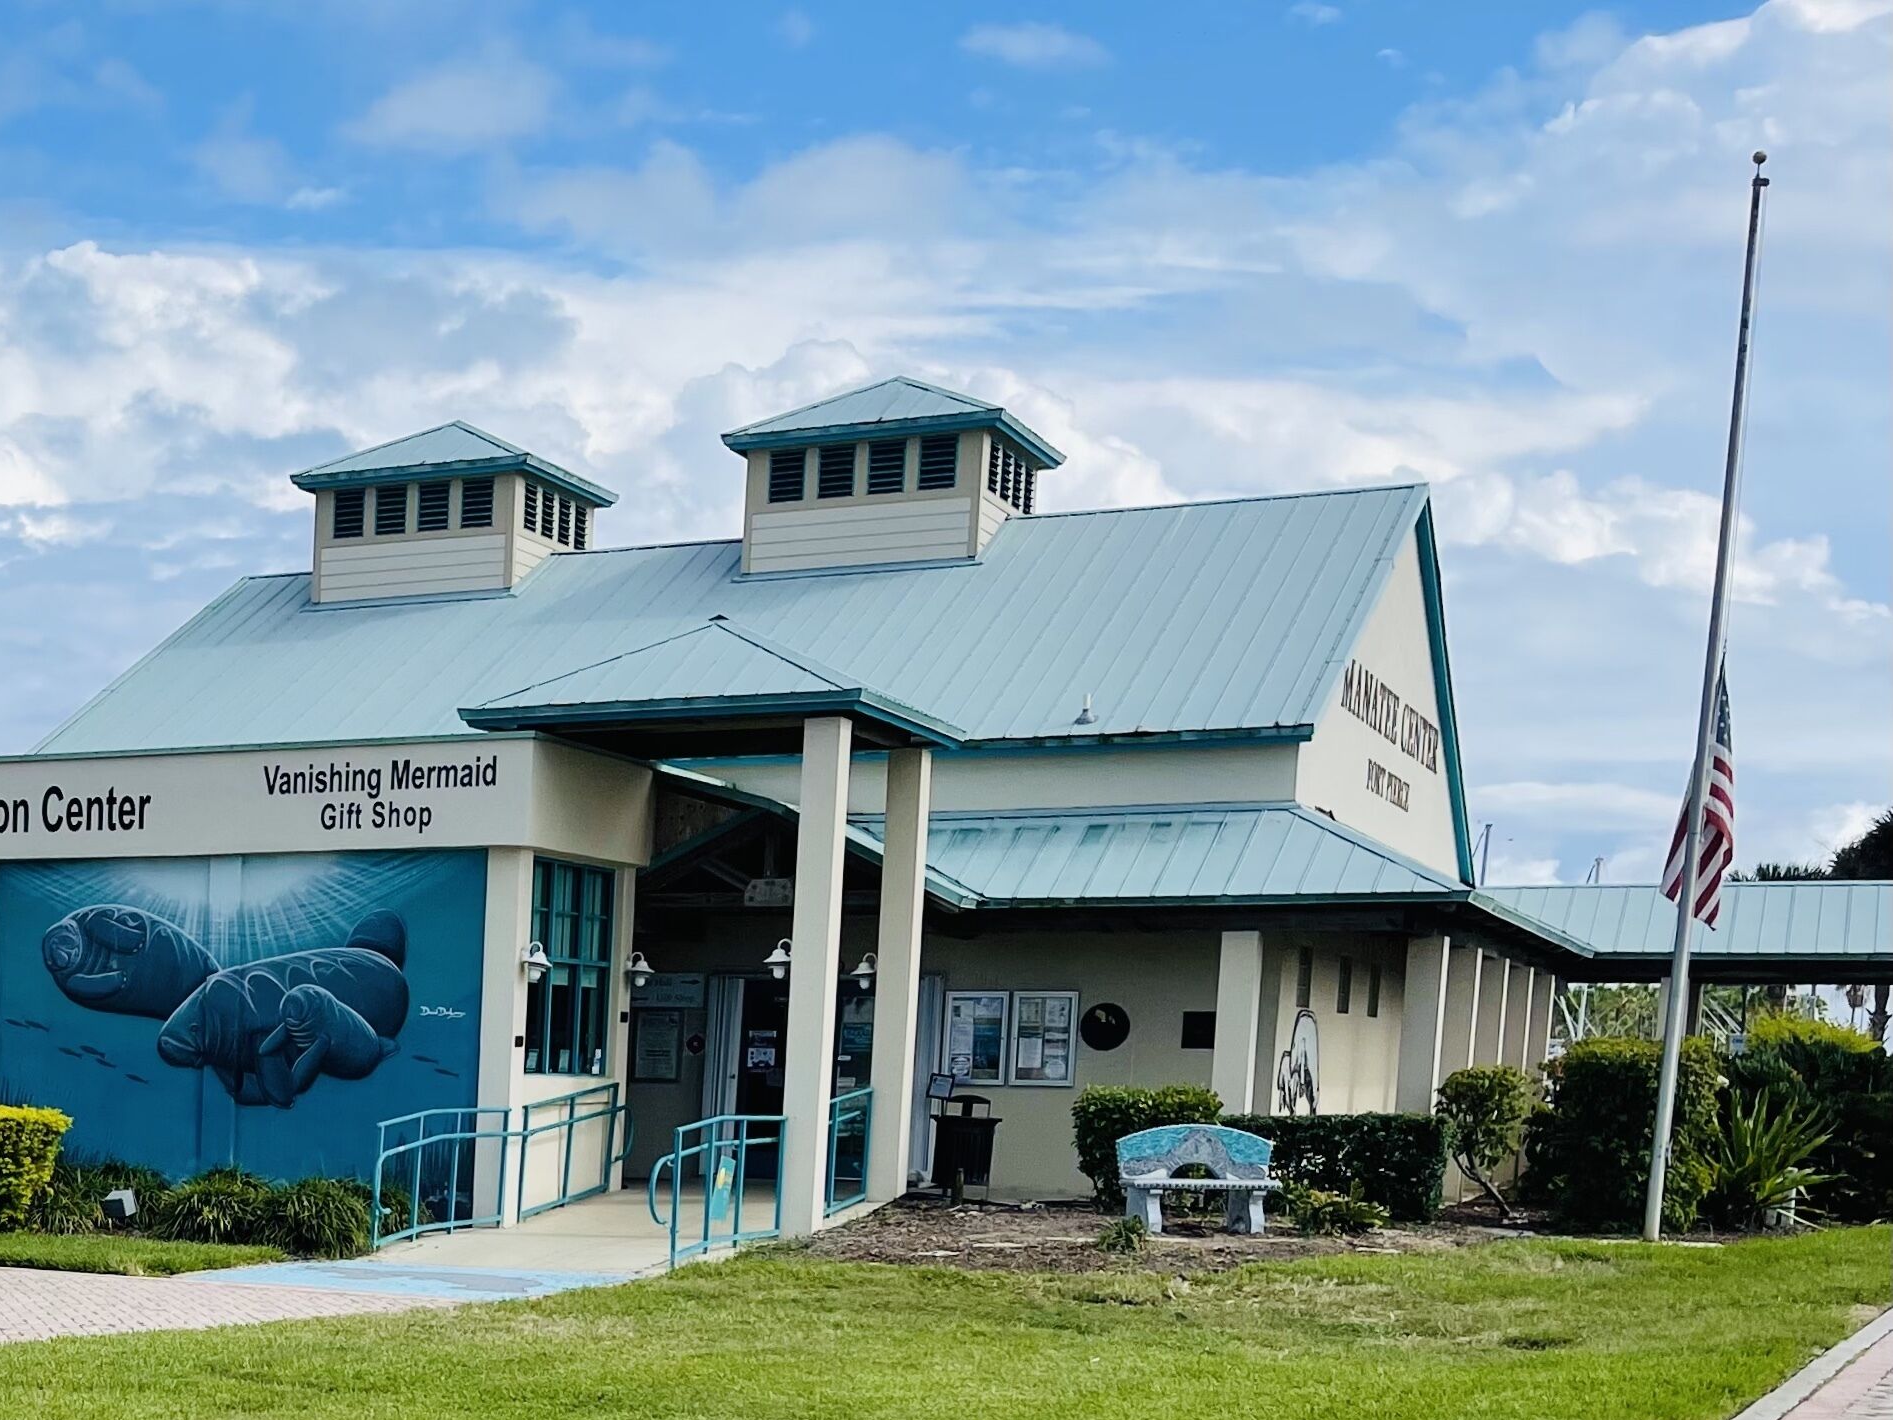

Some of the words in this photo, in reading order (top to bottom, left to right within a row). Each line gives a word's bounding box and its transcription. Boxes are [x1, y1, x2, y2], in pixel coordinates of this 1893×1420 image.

[1340, 658, 1400, 745] MANATEE
[1400, 703, 1439, 775] CENTER
[263, 762, 382, 799] Vanishing
[390, 755, 498, 790] Mermaid
[41, 785, 152, 833] Center
[320, 802, 362, 831] Gift
[371, 801, 432, 834] Shop
